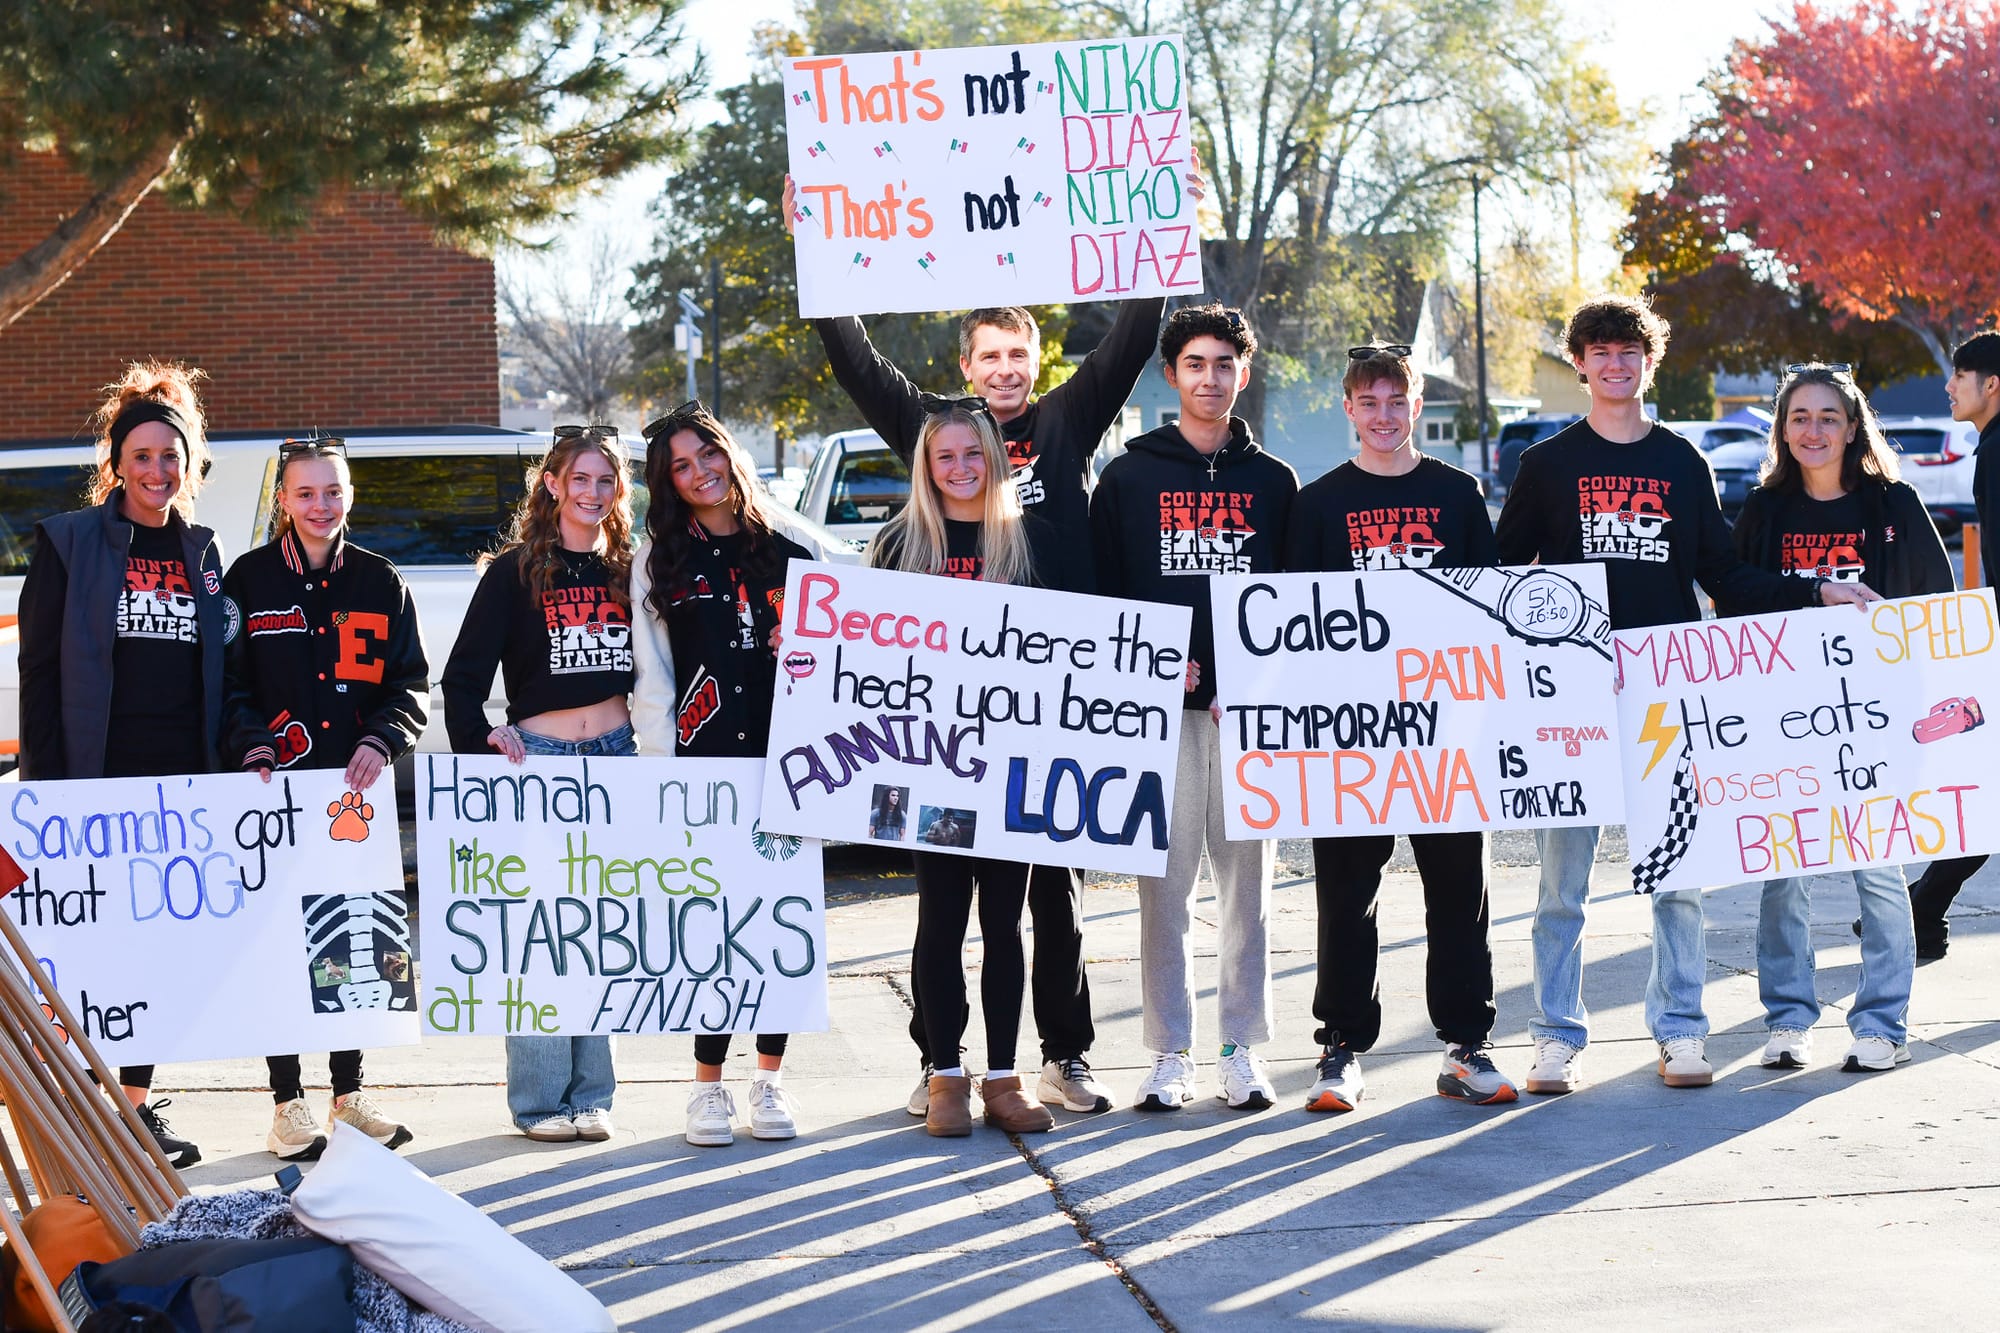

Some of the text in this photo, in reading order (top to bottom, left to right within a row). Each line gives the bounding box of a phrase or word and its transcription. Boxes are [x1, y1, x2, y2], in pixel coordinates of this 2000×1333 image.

[793, 40, 1180, 124] That's not NIKO
[1062, 109, 1184, 172] DIAZ
[800, 165, 1181, 241] That's not NIKO
[1070, 225, 1199, 295] DIAZ
[1159, 491, 1253, 509] COUNTRY
[1346, 507, 1440, 527] COUNTRY
[1578, 476, 1672, 495] COUNTRY
[1592, 491, 1663, 539] XC
[1160, 553, 1252, 575] STATE 25
[1362, 523, 1433, 571] XC
[1582, 536, 1670, 563] STATE 25
[116, 614, 178, 633] STATE
[541, 586, 609, 605] COUNT
[794, 572, 1182, 681] Becca where the
[1238, 578, 1390, 657] Caleb
[1526, 607, 1568, 626] 16:50
[1529, 587, 1557, 608] 5K
[332, 611, 388, 685] E
[549, 648, 633, 672] STATE 25
[1396, 644, 1556, 700] PAIN is
[1614, 593, 1994, 689] MADDAX is SPEED
[678, 677, 720, 744] 2027
[833, 645, 1167, 746] heck you been
[1226, 700, 1438, 751] TEMPORARY
[1680, 677, 1890, 752] He eats
[779, 714, 988, 810] RUNNING
[1536, 727, 1609, 741] STRAVA
[428, 755, 738, 827] Hannah run
[1004, 756, 1169, 851] LOCA
[1236, 741, 1528, 829] STRAVA is
[1500, 781, 1587, 820] FOREVER
[1692, 743, 1888, 808] losers for
[235, 776, 303, 891] got
[1736, 784, 1980, 873] BREAKFAST
[10, 852, 245, 926] that DOG
[450, 830, 721, 898] like there's
[445, 896, 816, 978] STARBUCKS
[81, 990, 148, 1041] her
[428, 975, 766, 1034] at the FINISH
